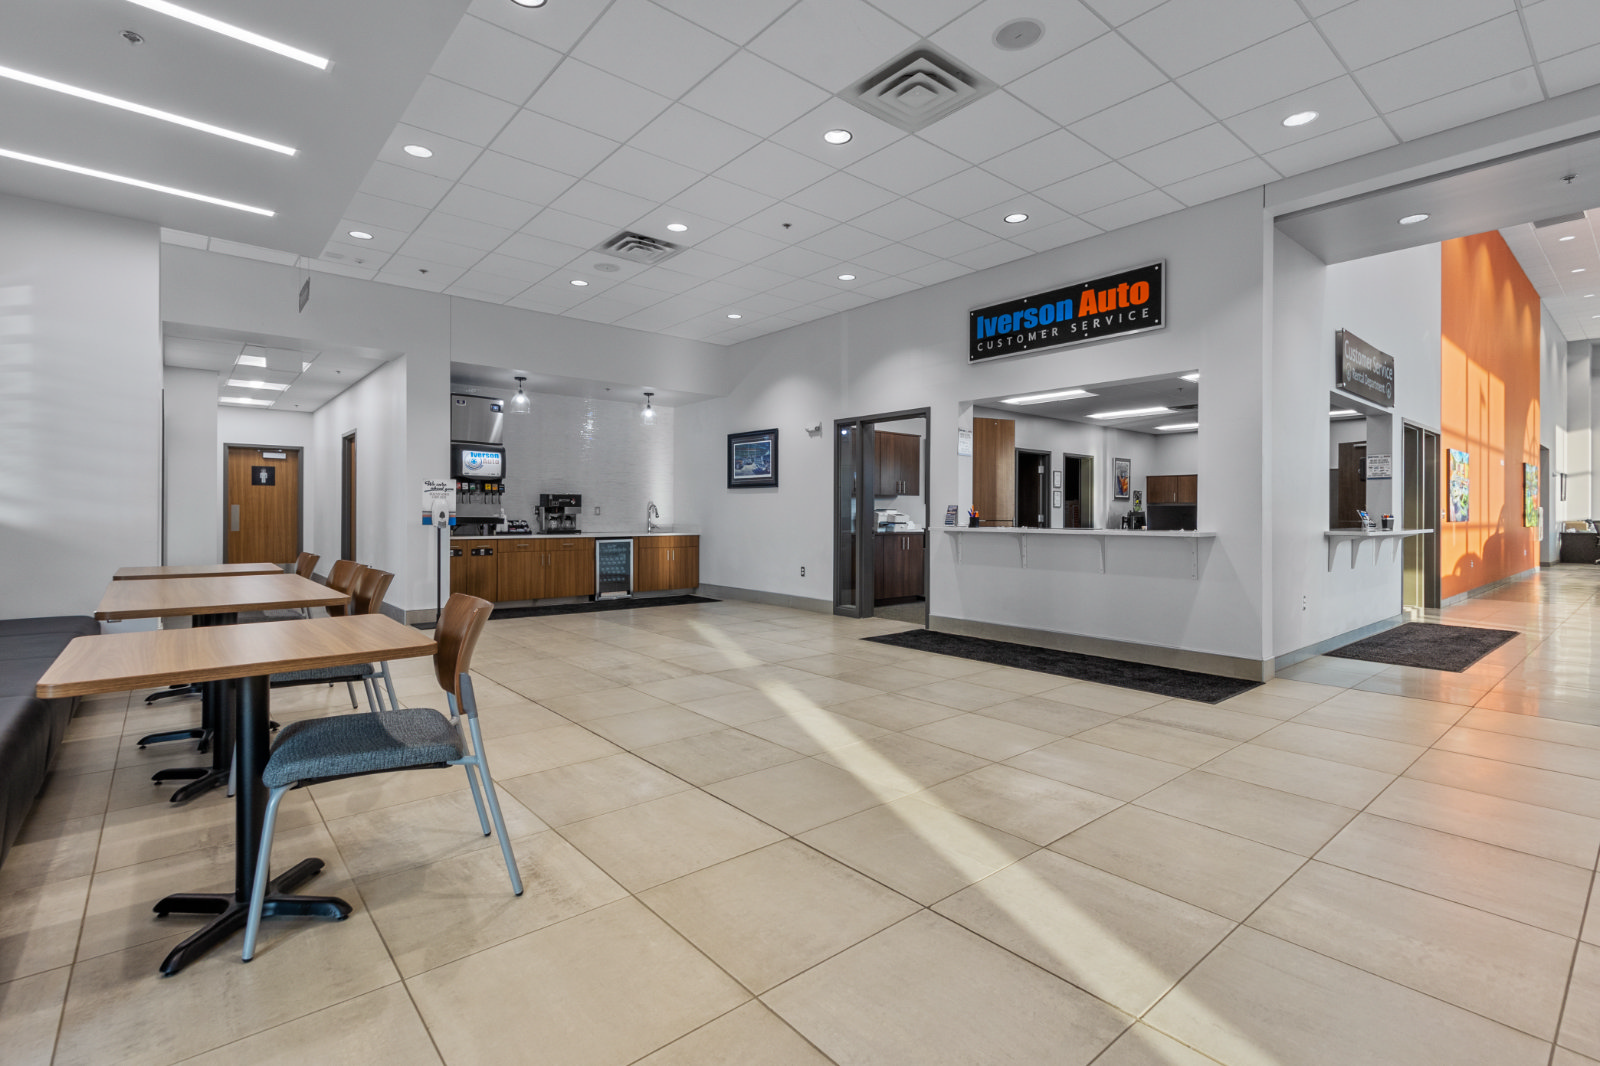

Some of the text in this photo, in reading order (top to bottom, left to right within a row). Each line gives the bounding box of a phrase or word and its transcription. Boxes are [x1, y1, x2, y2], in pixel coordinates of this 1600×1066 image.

[977, 280, 1150, 340] Iverson Auto
[977, 307, 1149, 352] CUSTOMER SERVICE
[1344, 339, 1393, 381] Customer Service
[1364, 374, 1385, 394] Department
[470, 451, 500, 459] Iverson
